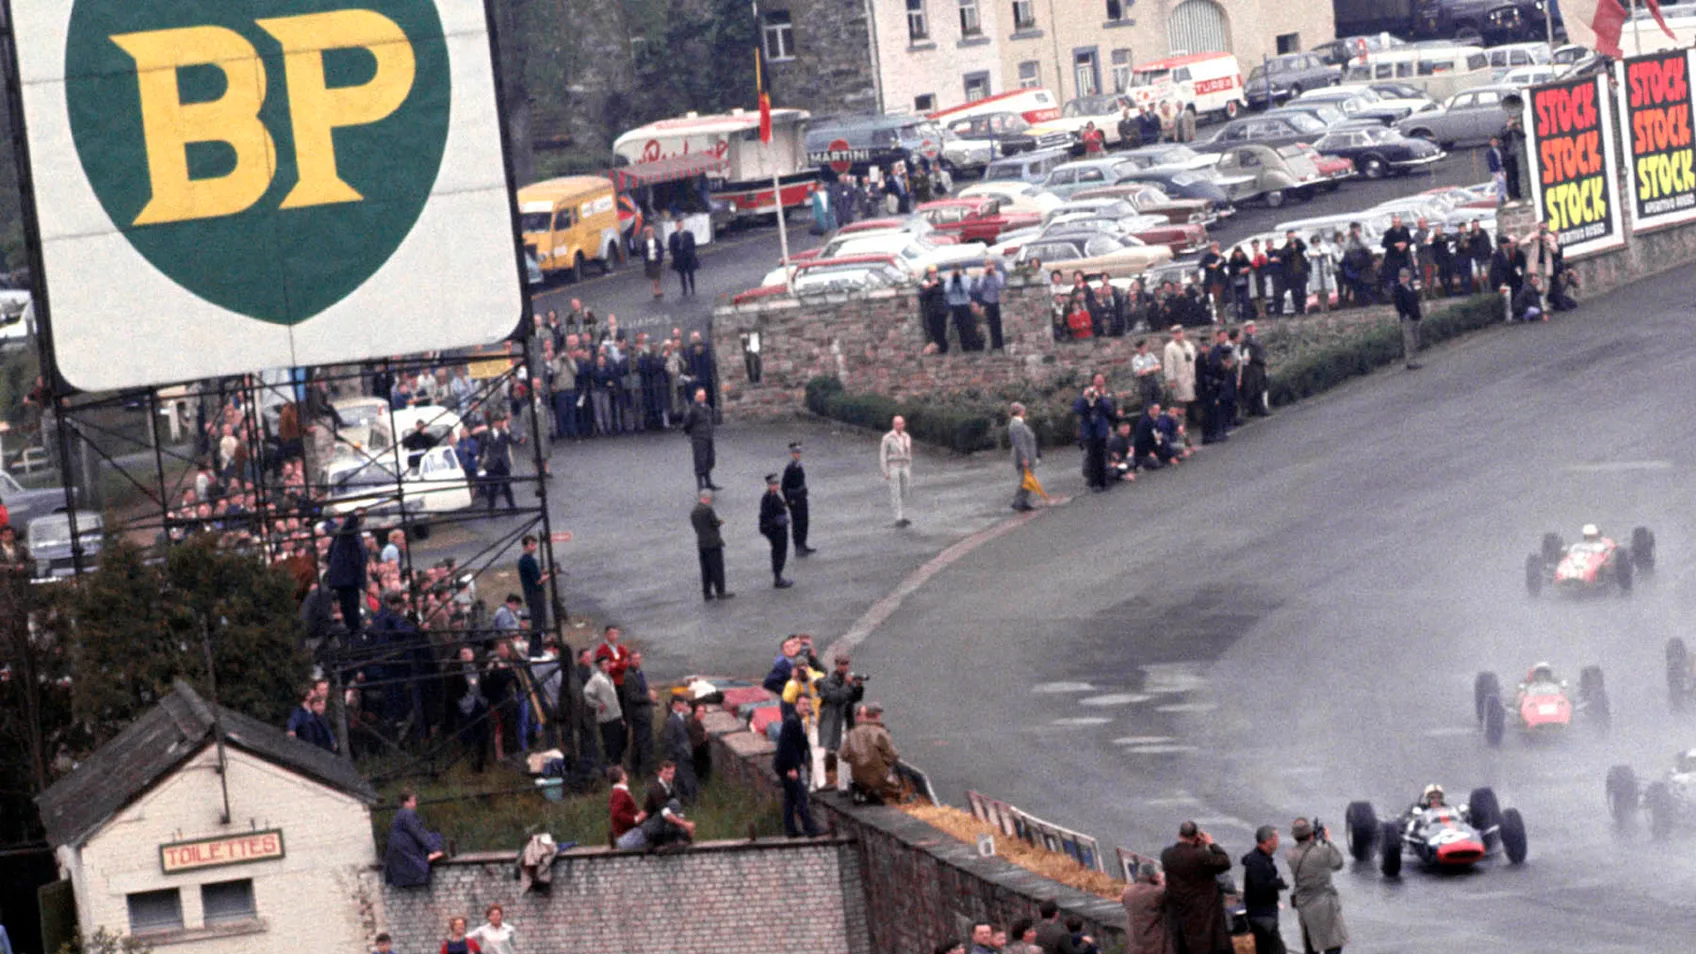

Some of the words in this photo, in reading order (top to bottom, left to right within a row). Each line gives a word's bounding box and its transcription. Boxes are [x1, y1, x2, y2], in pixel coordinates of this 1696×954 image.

[1628, 57, 1687, 107] STOCK
[108, 8, 416, 226] BP
[1536, 82, 1596, 136] STOCK
[1633, 104, 1690, 154] STOCK
[809, 150, 870, 164] MARTINI
[1541, 130, 1602, 184] STOCK
[1638, 149, 1695, 200] STOCK
[1546, 176, 1606, 232] STOCK
[165, 835, 277, 866] TOILETTES
